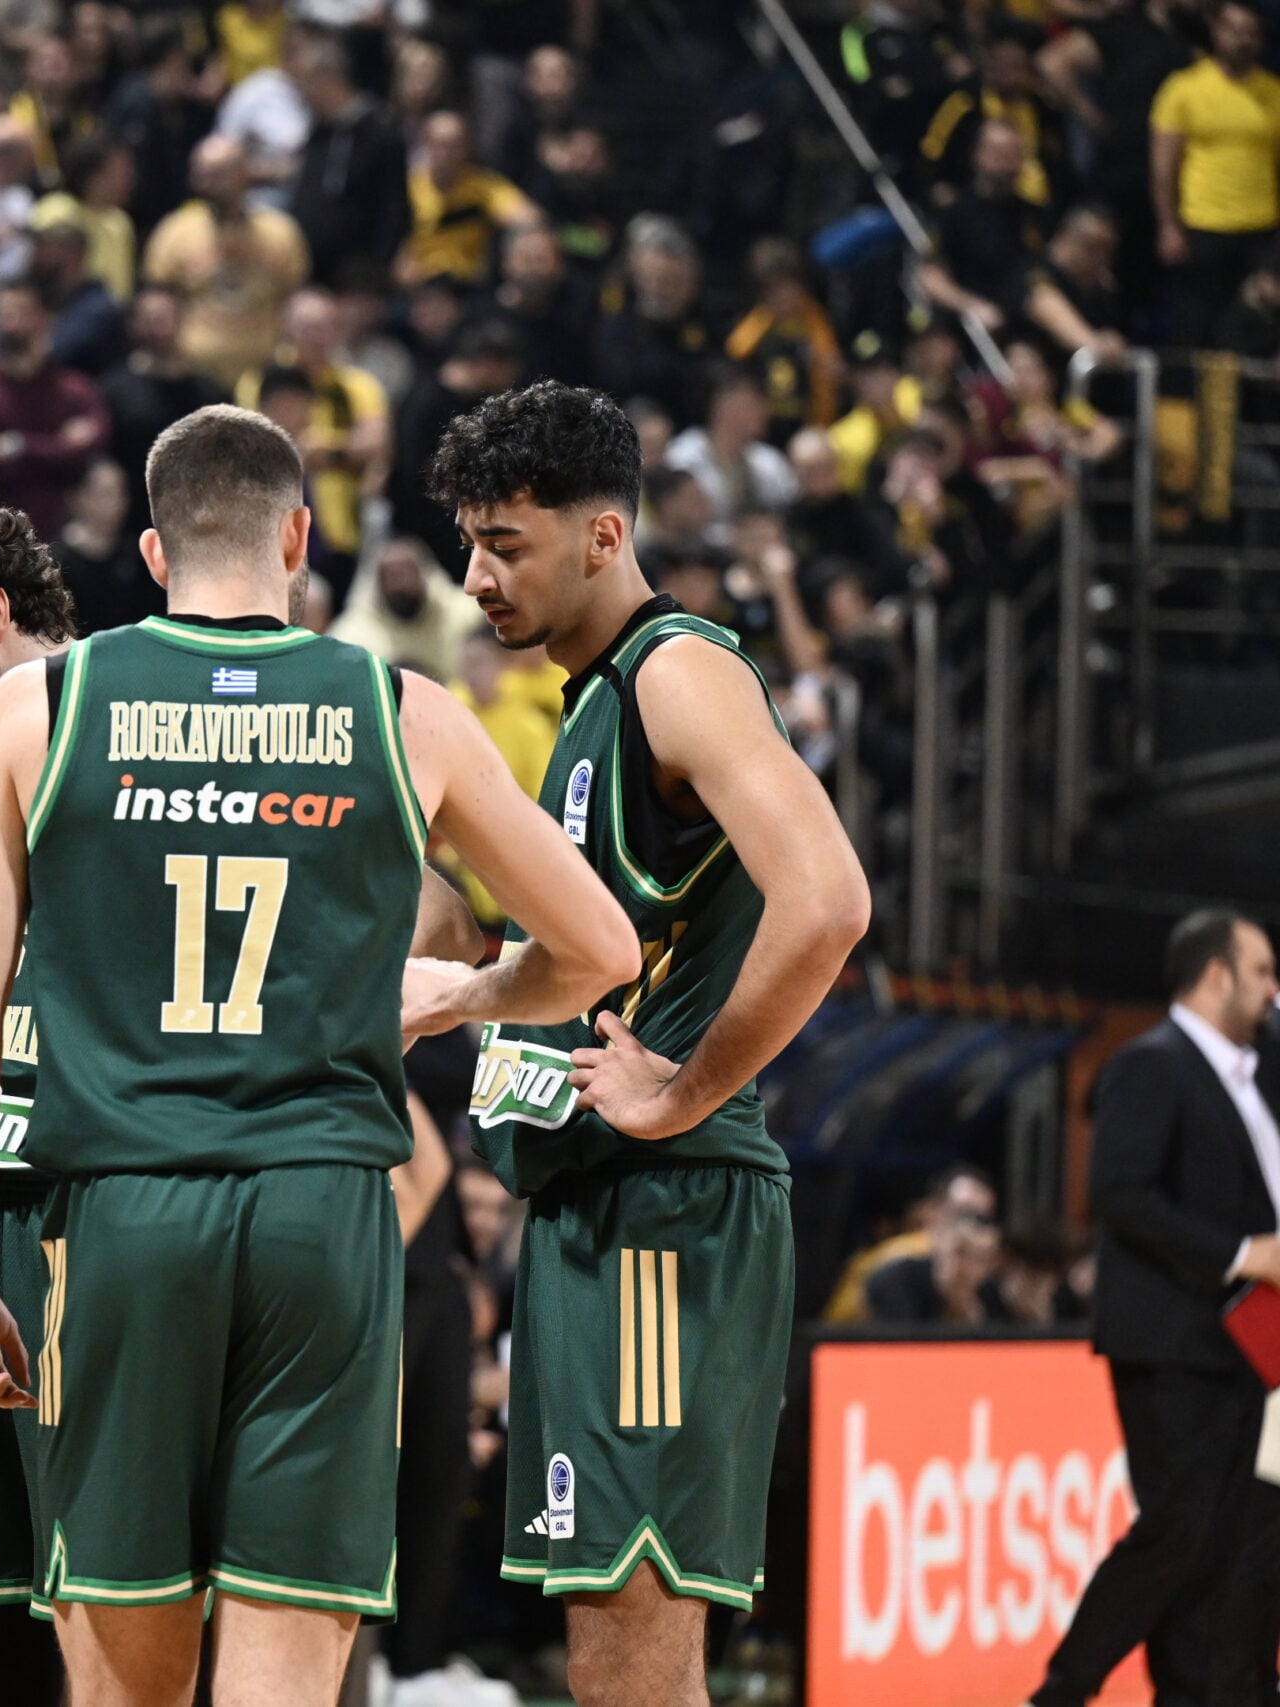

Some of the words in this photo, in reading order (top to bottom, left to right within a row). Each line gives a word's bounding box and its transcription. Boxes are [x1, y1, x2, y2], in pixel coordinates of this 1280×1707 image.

[108, 701, 353, 765] ROGKAVOPOULOS
[113, 774, 355, 828] instacar
[569, 825, 580, 836] GBL
[161, 854, 289, 1034] 17
[556, 1521, 567, 1532] GBL
